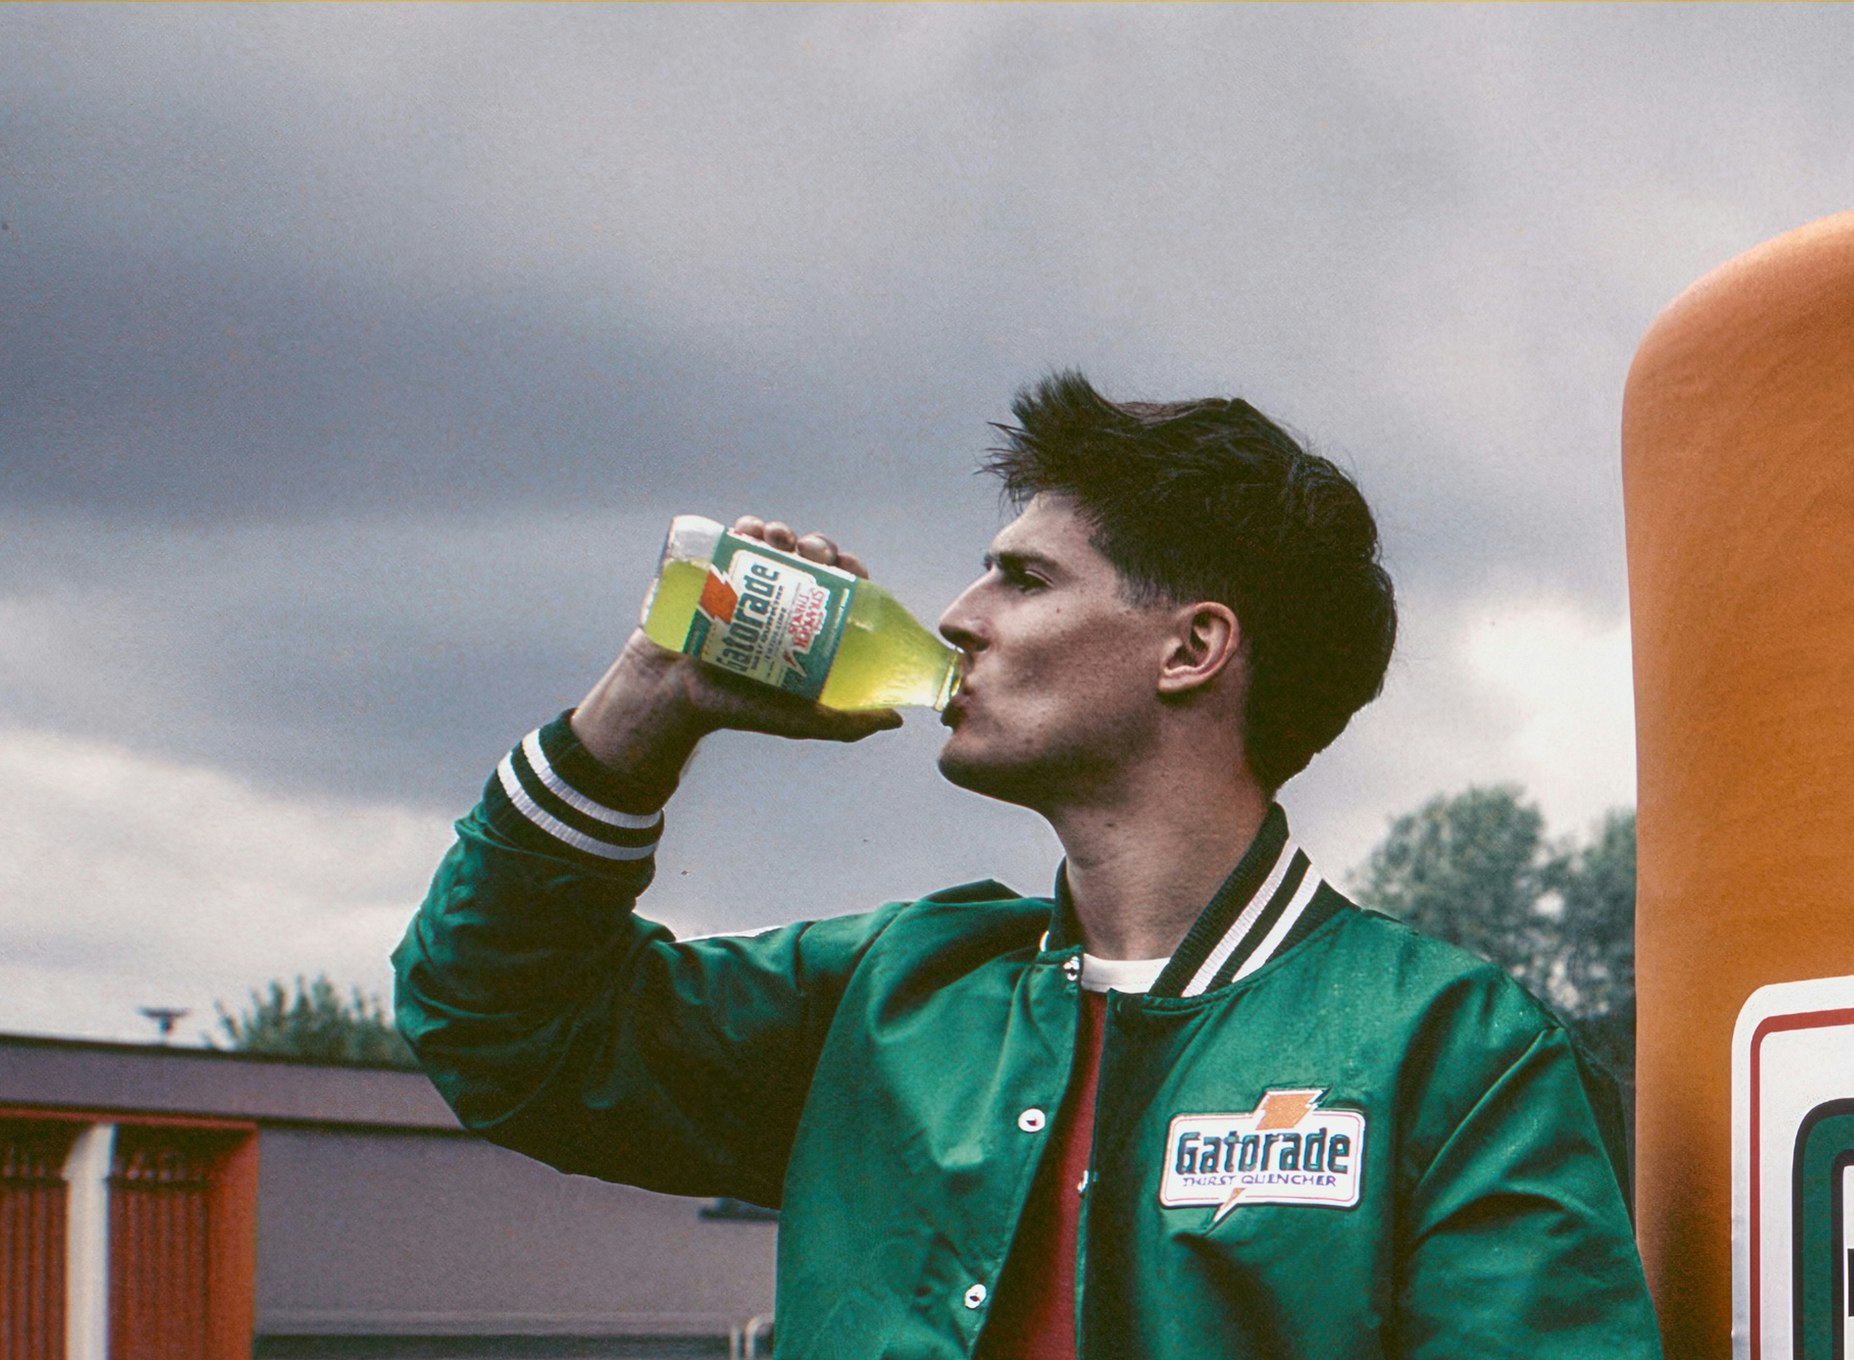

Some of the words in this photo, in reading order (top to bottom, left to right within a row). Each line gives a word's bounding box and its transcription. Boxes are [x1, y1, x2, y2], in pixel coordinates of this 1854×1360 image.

[1175, 1127, 1351, 1175] Gatorade
[1182, 1174, 1236, 1187] THIRST
[1241, 1173, 1337, 1187] QUENCHER
